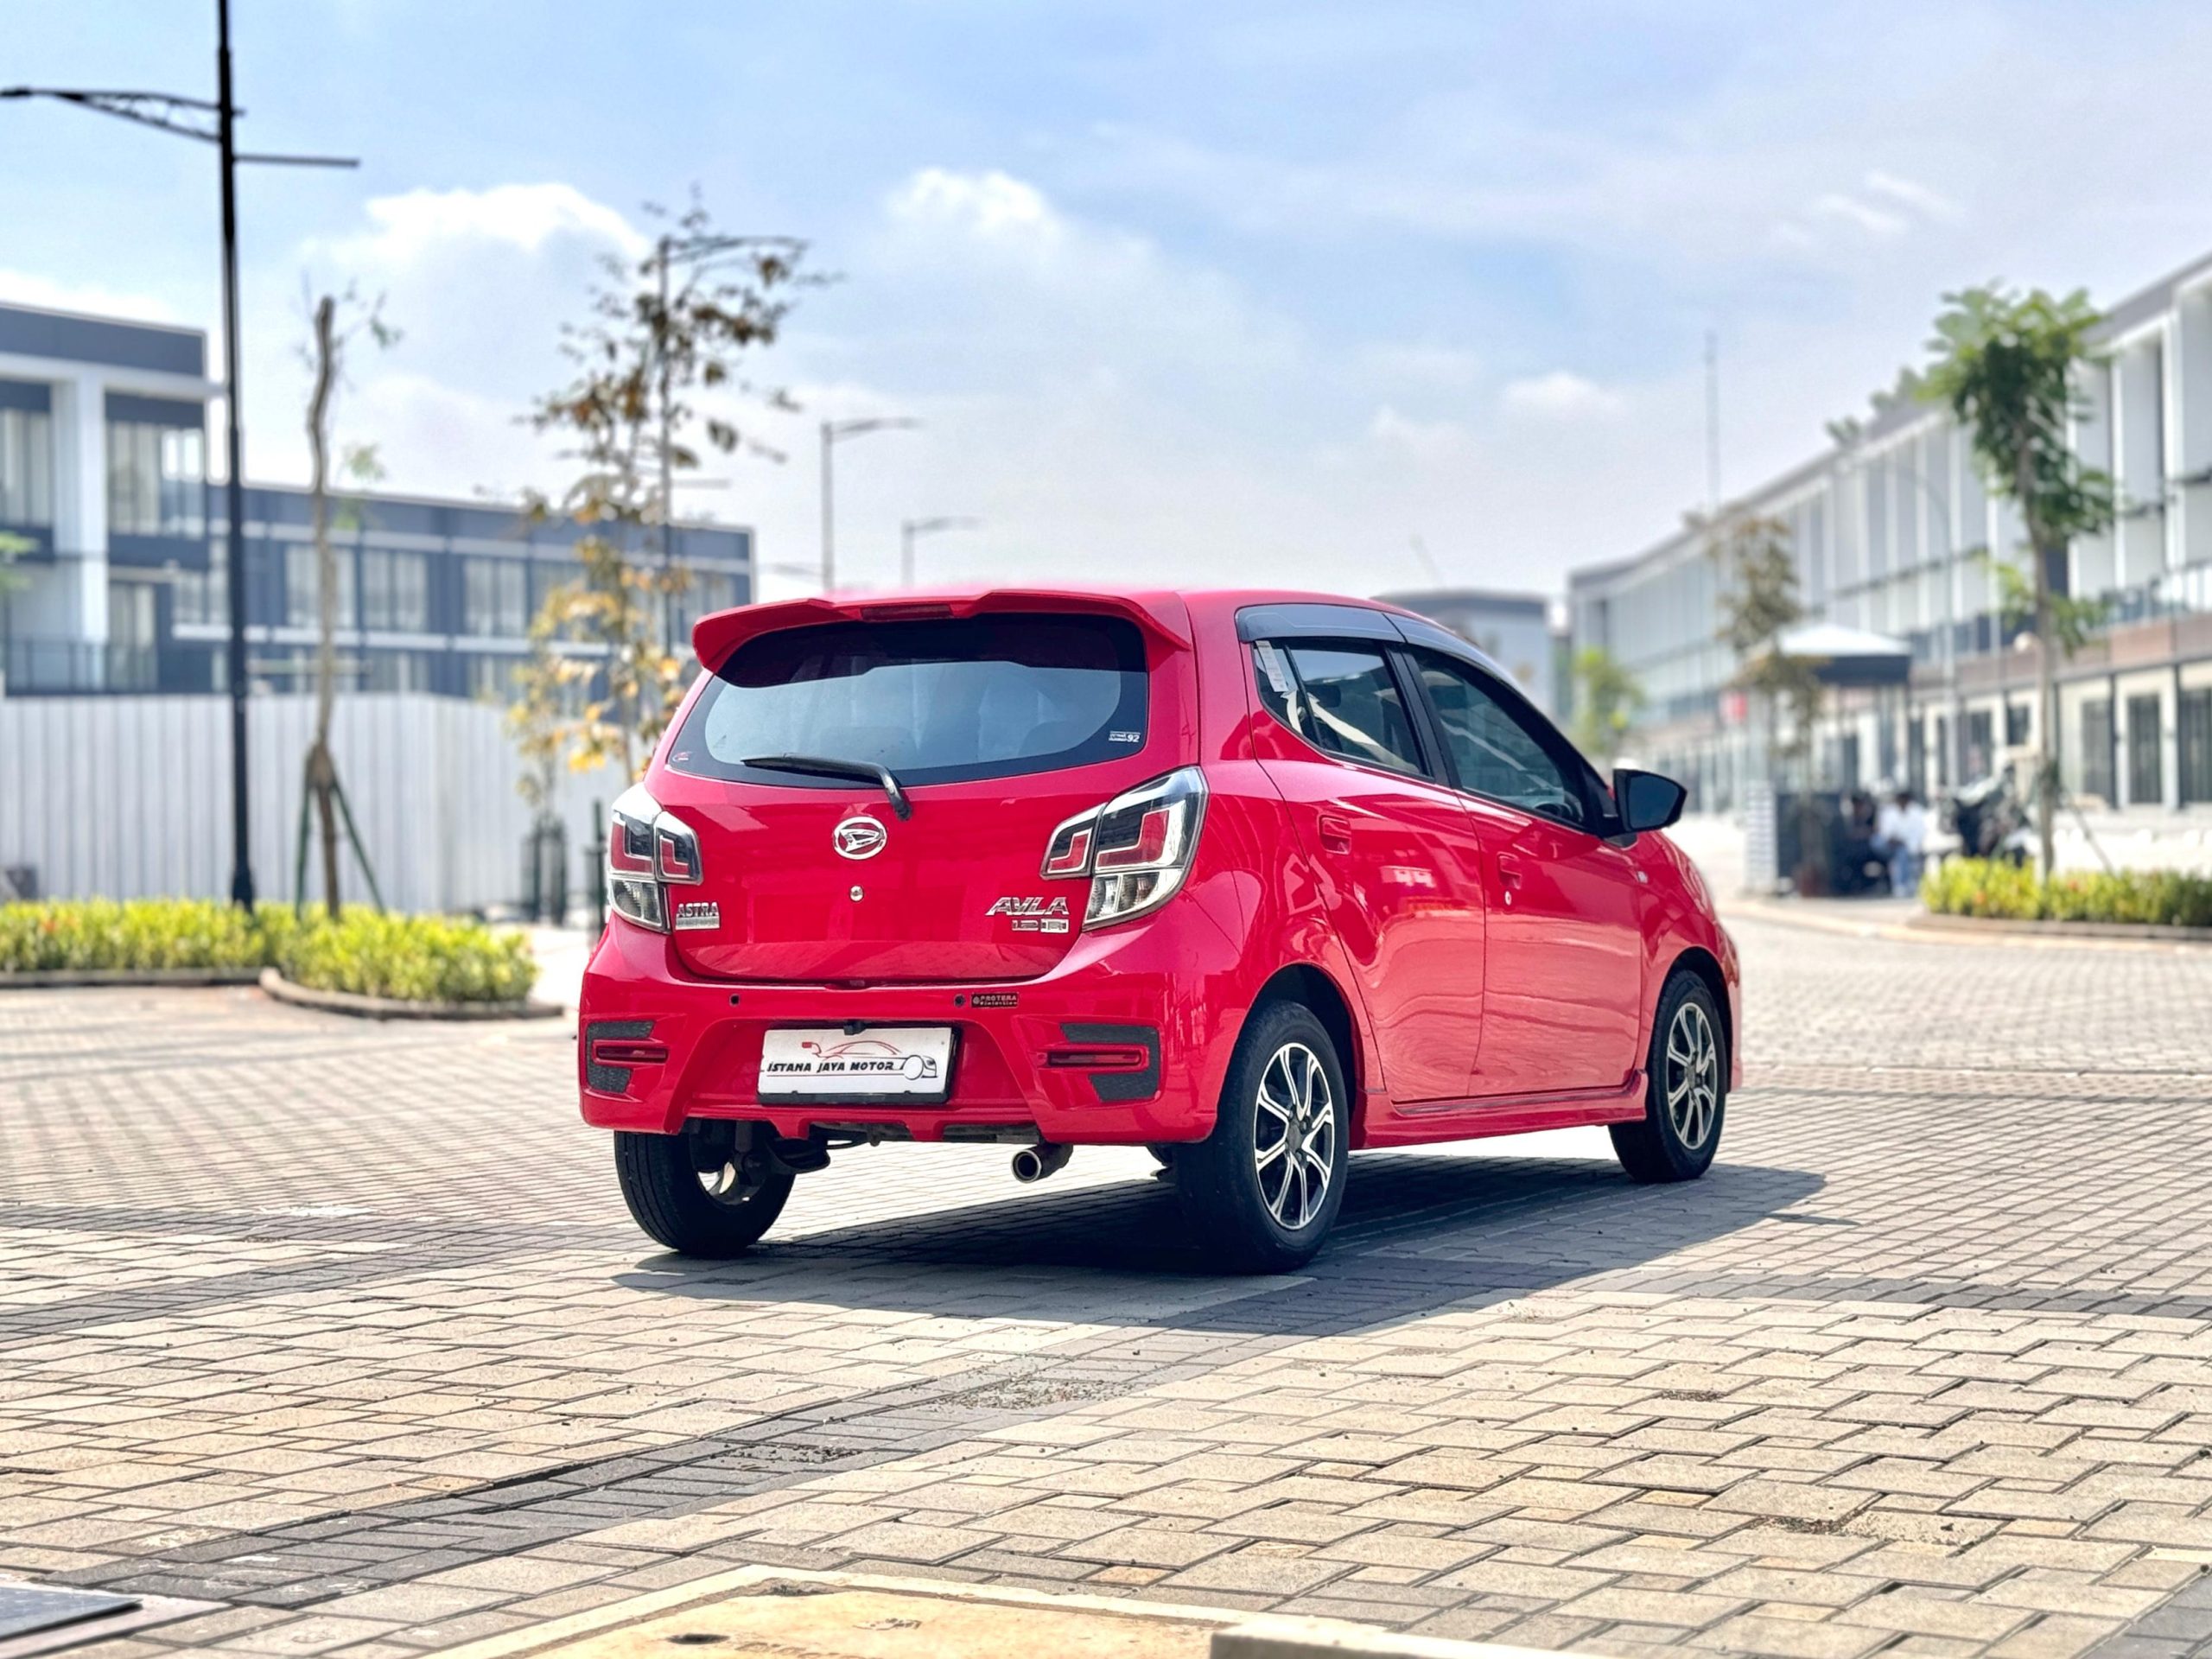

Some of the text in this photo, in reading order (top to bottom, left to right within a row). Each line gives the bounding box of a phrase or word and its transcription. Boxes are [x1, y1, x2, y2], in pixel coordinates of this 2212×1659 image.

[676, 902, 720, 918] ASTRA
[767, 1061, 895, 1073] ISTANA JAYA MOTOR
